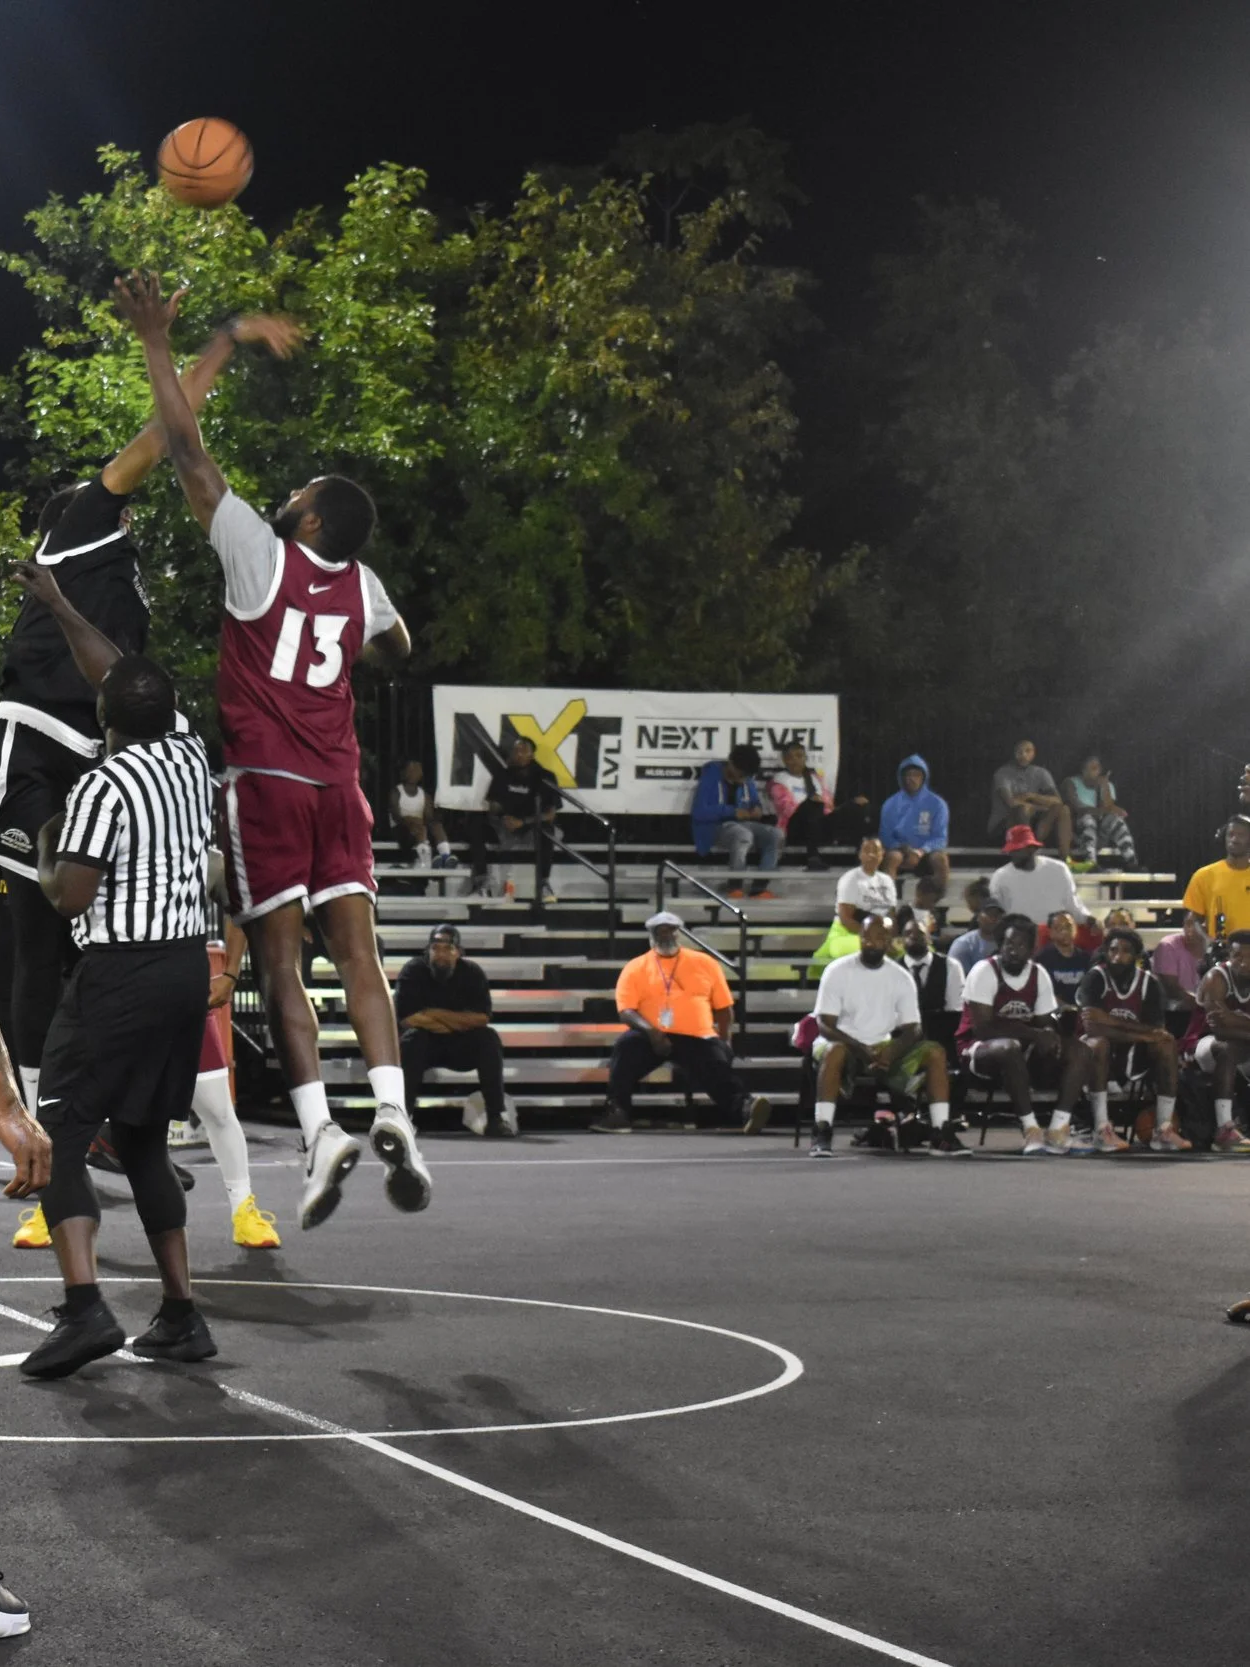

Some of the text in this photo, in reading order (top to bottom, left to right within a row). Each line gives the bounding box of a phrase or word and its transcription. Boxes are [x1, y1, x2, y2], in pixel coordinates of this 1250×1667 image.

[269, 607, 349, 688] 13
[450, 698, 623, 790] NXT
[601, 739, 621, 789] LVL
[637, 725, 823, 751] NEXT LEVEL
